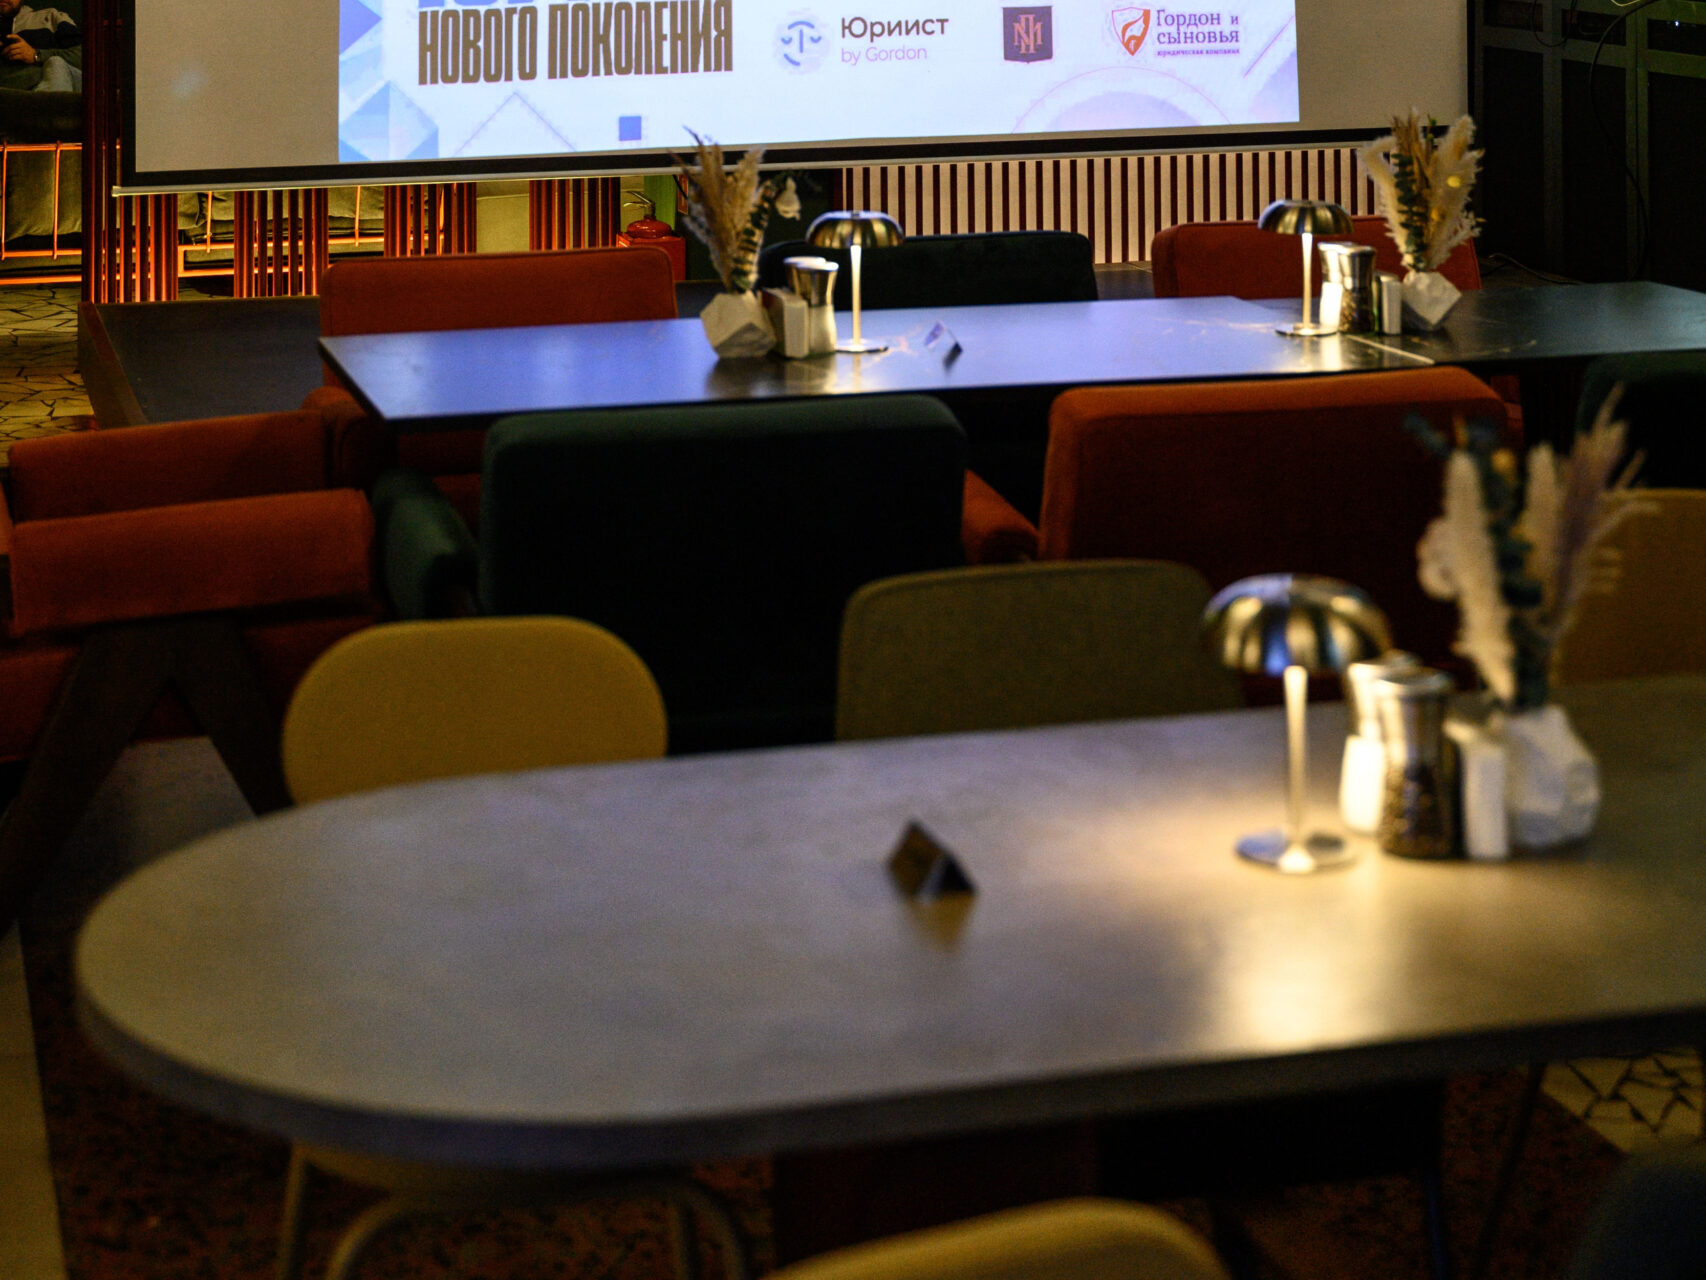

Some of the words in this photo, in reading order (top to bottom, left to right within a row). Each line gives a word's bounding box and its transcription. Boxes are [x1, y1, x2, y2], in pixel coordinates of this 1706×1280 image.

[840, 16, 949, 43] Юриист
[1156, 9, 1221, 32] Гордон
[1230, 15, 1239, 25] и
[418, 5, 538, 86] НОВОГО
[1156, 30, 1240, 45] сыновья
[841, 47, 861, 66] by
[865, 45, 928, 62] Gordon
